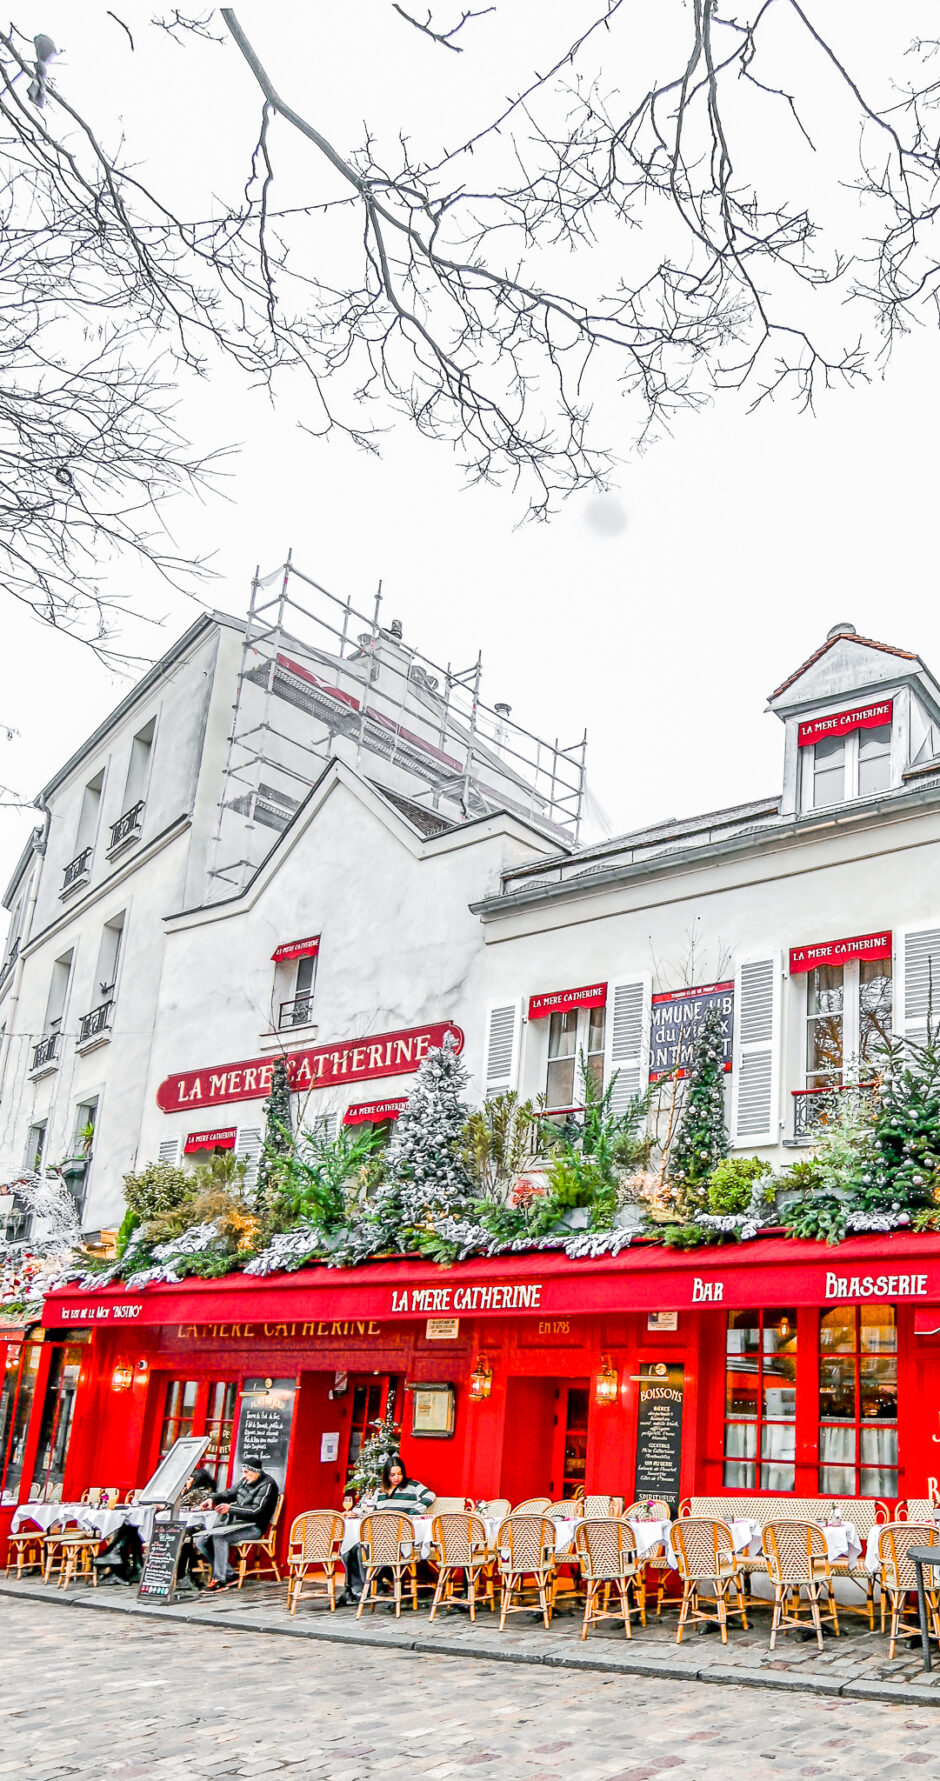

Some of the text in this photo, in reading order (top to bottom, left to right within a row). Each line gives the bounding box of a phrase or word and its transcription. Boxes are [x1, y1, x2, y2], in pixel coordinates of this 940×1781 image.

[802, 705, 890, 736] LA MERE CATHERINE
[793, 936, 887, 961] LA MERE CATHERINE
[532, 987, 603, 1008] LA MERE CATHERINE
[656, 1025, 675, 1043] du
[177, 1034, 431, 1102] LA MERE CATHERINE
[359, 1106, 376, 1115] MERE
[692, 1278, 724, 1302] BAR
[825, 1272, 928, 1299] BRASSERIE
[391, 1285, 542, 1312] LA MERE CATHERINE
[640, 1387, 683, 1403] BOISSONS
